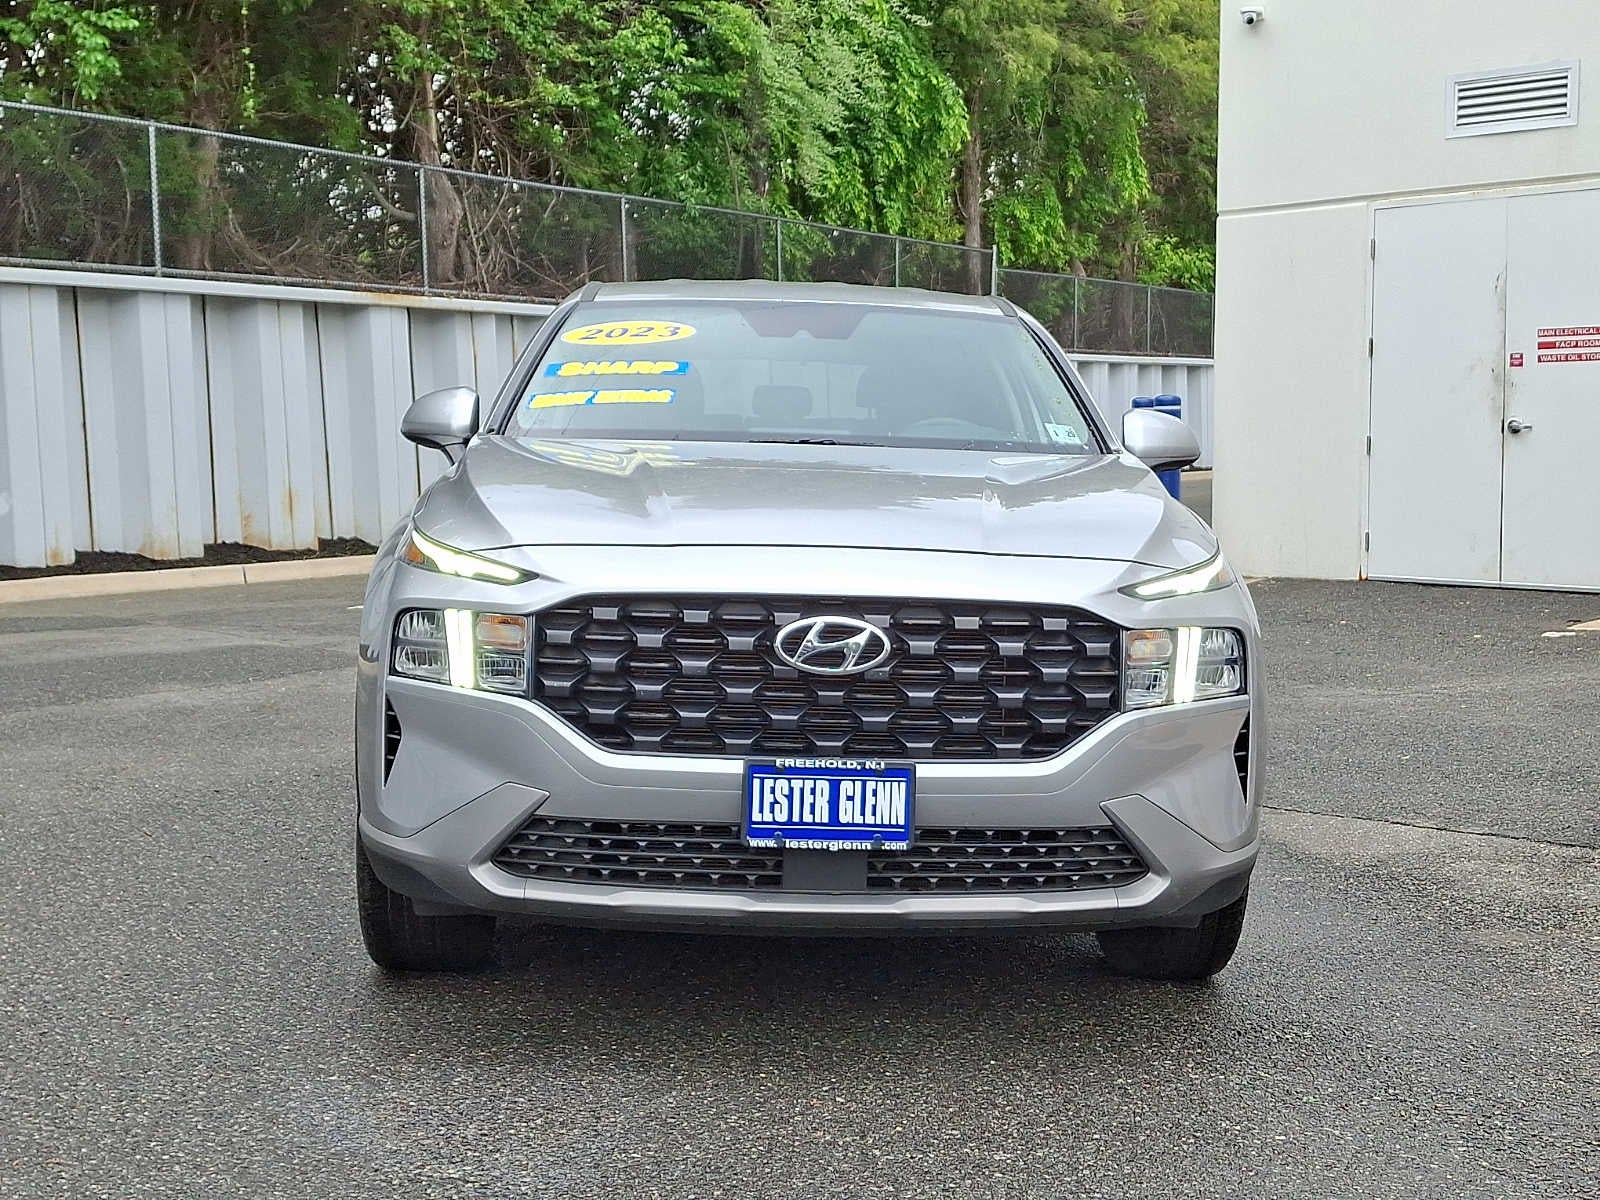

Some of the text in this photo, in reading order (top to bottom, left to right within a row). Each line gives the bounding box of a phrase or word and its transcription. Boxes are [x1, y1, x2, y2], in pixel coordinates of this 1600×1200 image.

[578, 326, 682, 341] 2023
[1555, 327, 1597, 336] ELECTRICAL
[1555, 340, 1577, 348] FACP
[1540, 354, 1567, 362] WASTE
[1567, 353, 1580, 361] OIL
[557, 361, 680, 377] SHARP
[775, 758, 862, 770] FREEHOLD,
[751, 777, 907, 826] LESTER GLENN
